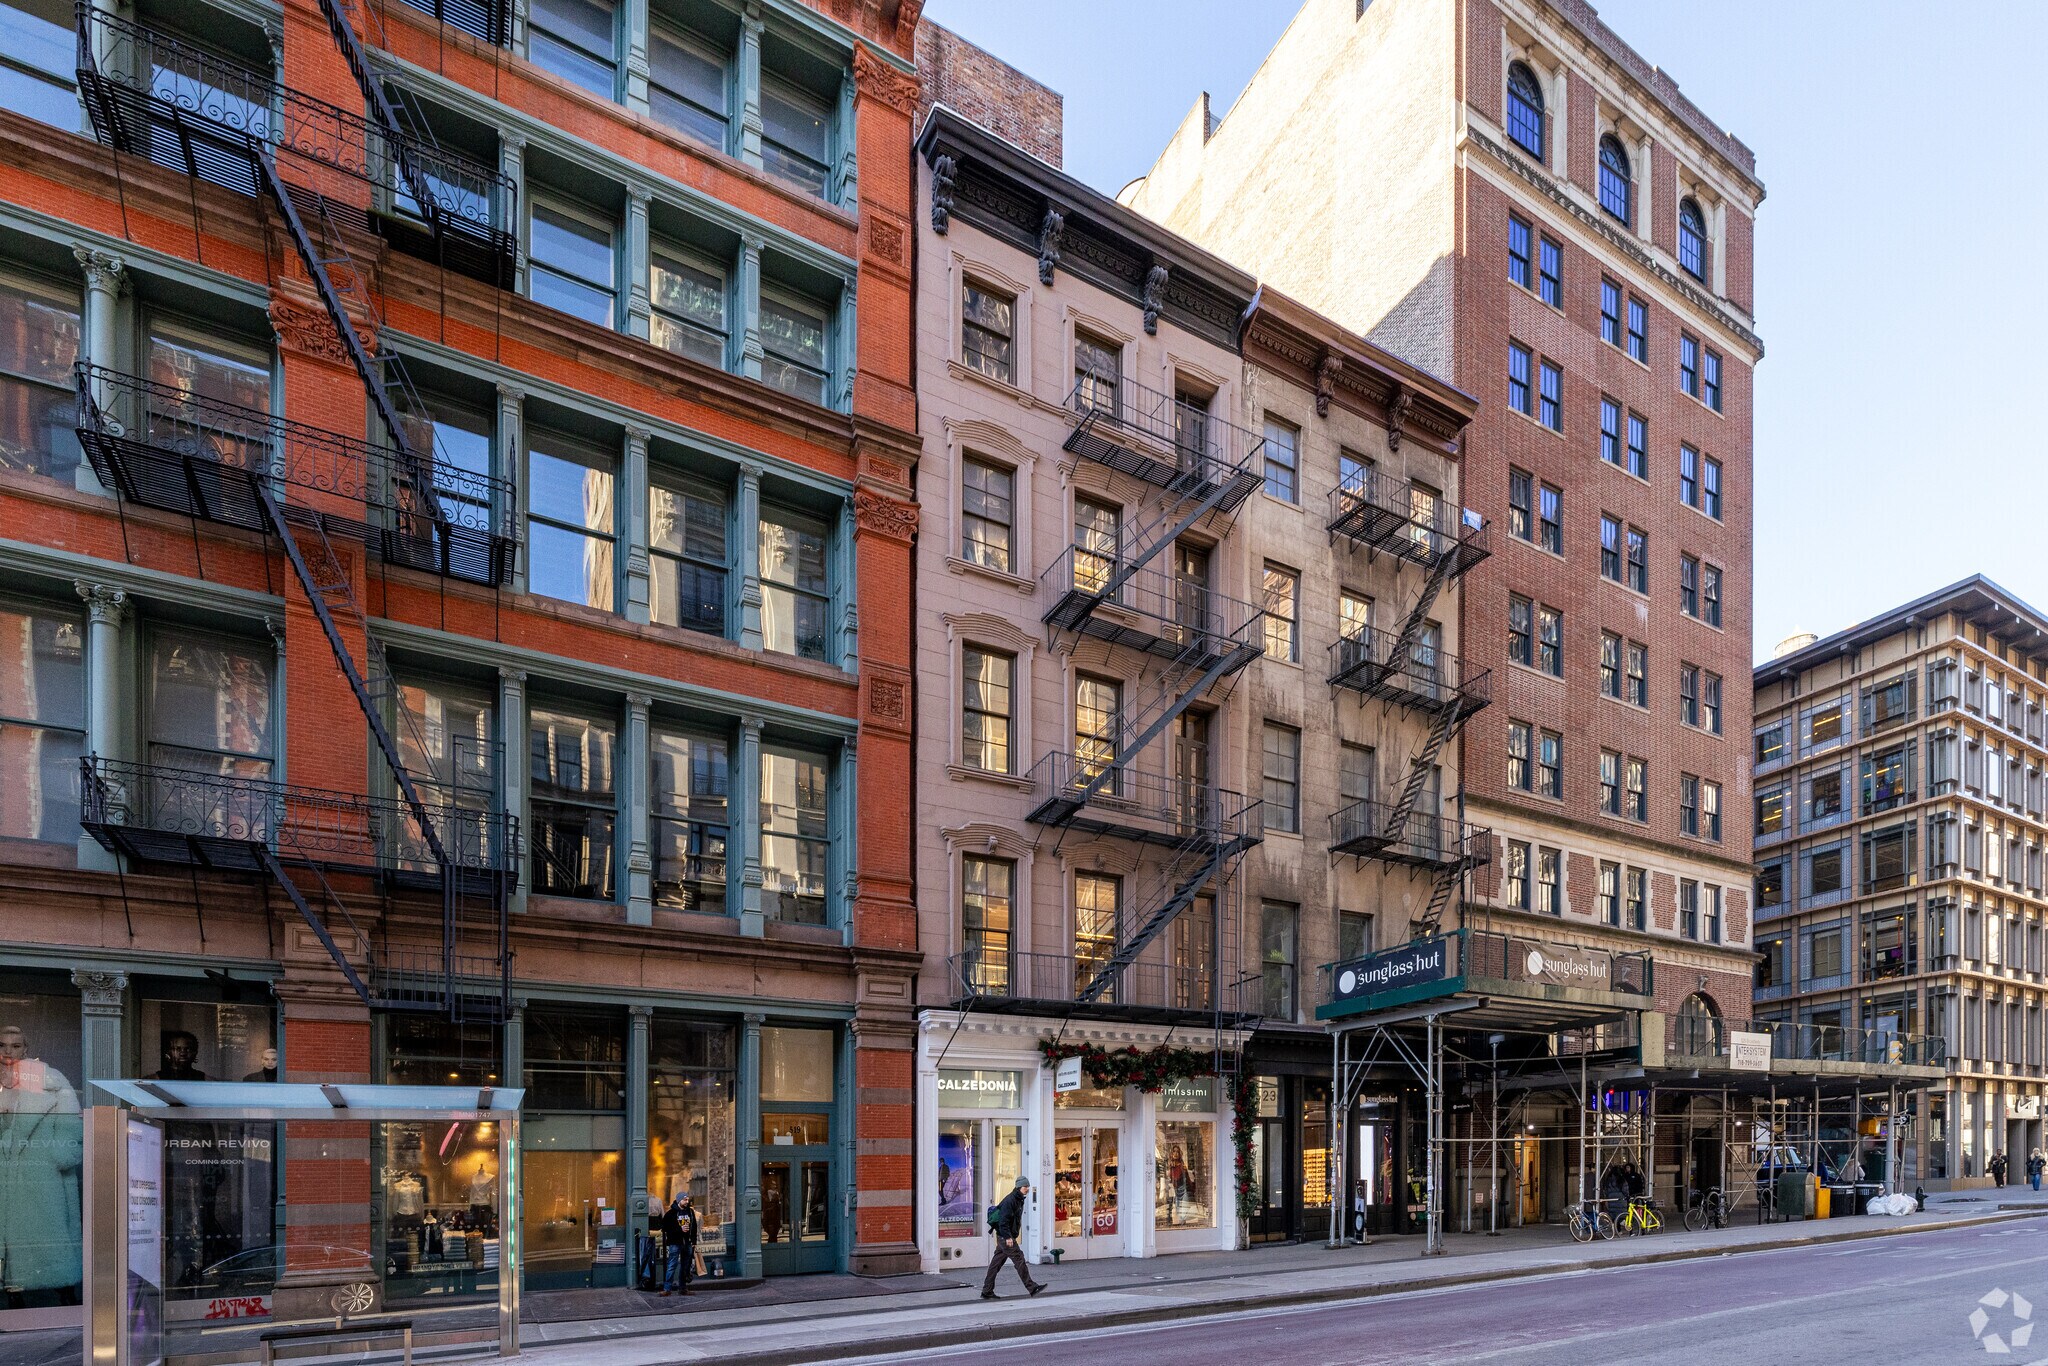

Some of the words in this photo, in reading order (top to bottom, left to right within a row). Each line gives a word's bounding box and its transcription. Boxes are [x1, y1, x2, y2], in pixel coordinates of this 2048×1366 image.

[1357, 959, 1414, 986] sunglass
[1416, 951, 1440, 970] hut
[1544, 958, 1589, 978] sunglass
[1590, 960, 1607, 979] hut
[937, 1079, 1017, 1091] CALZEDONIA
[1057, 1081, 1077, 1089] CALZEDONIA
[789, 1125, 801, 1134] 519
[218, 1139, 271, 1148] REVIVO
[1096, 1213, 1115, 1227] 60
